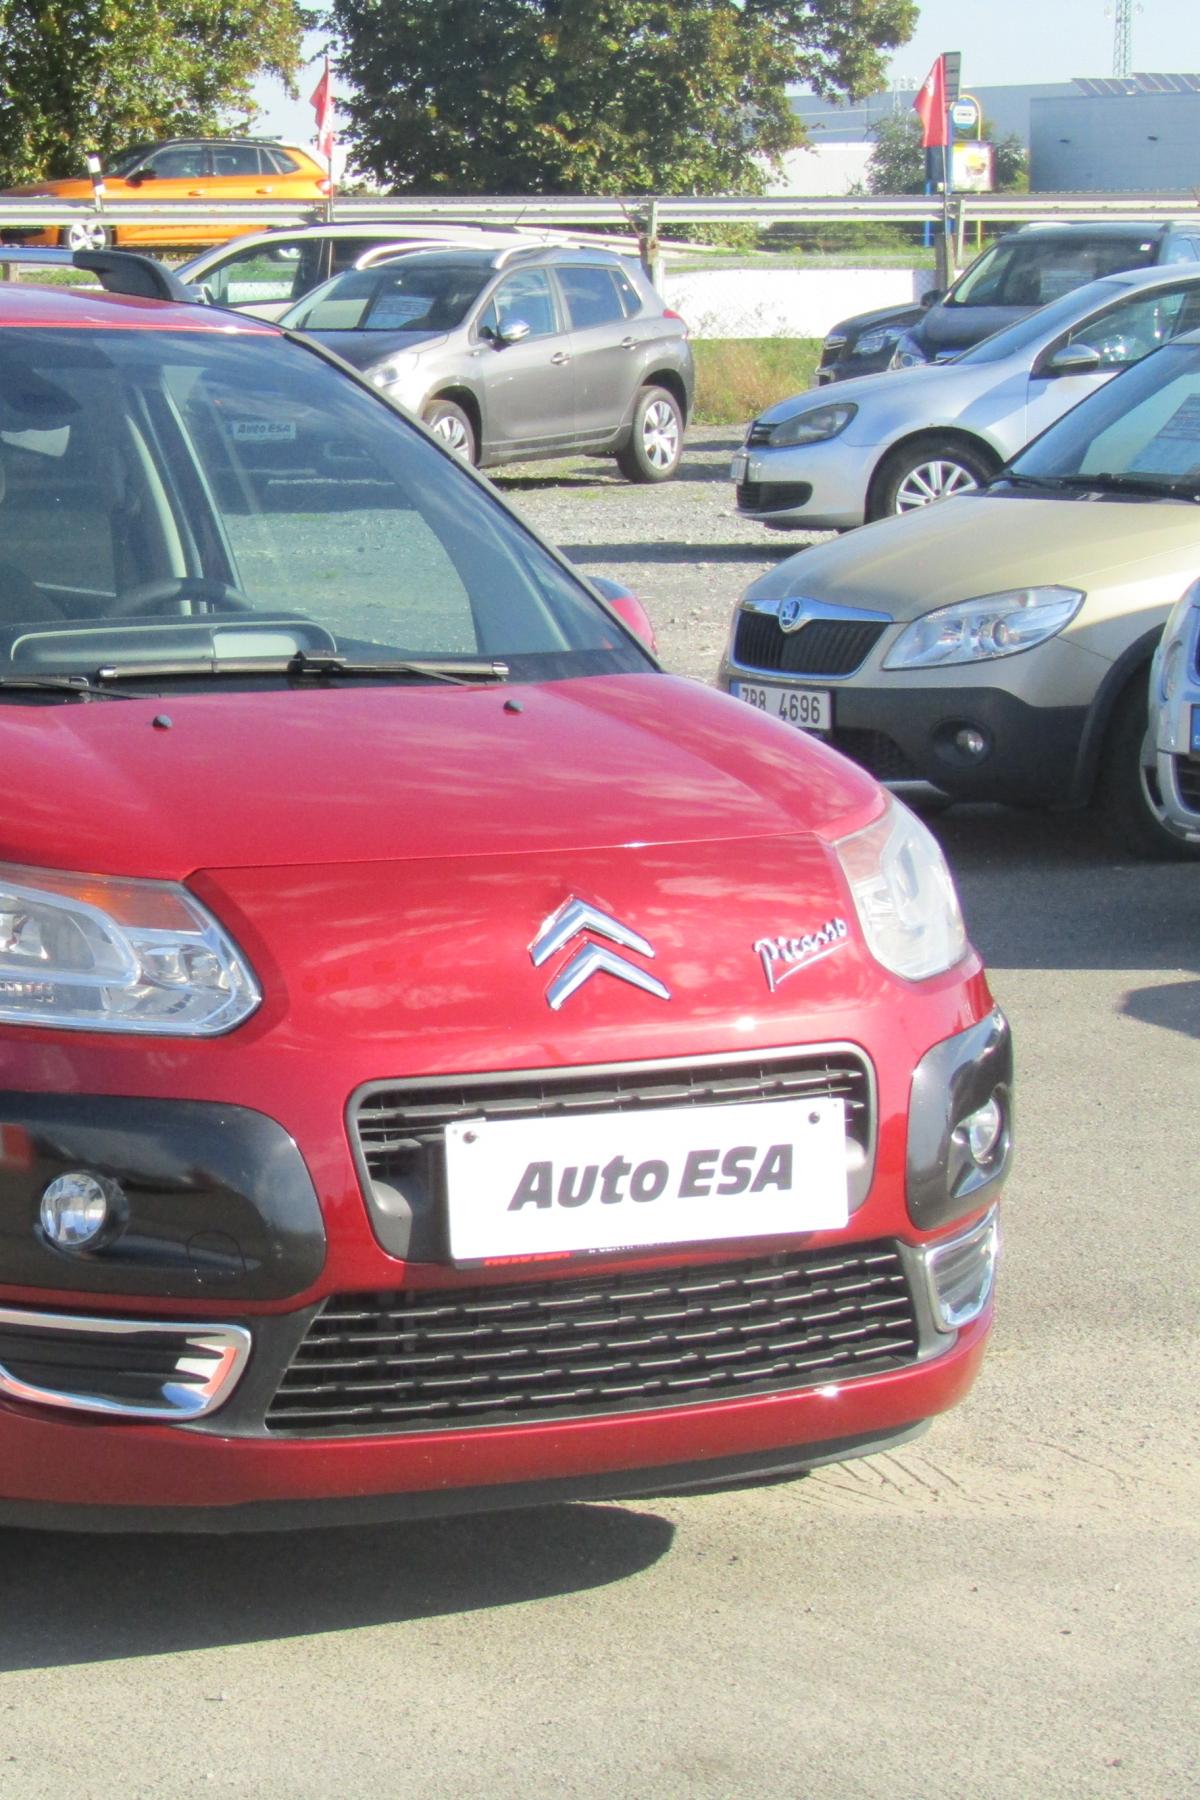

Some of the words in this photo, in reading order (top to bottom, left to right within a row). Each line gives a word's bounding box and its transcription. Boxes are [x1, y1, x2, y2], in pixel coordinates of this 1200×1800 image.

[237, 423, 267, 434] Auto
[268, 423, 291, 433] ESA
[779, 693, 821, 724] 4696
[753, 917, 850, 993] Picasso
[507, 1155, 670, 1211] Auto
[677, 1143, 793, 1199] ESA
